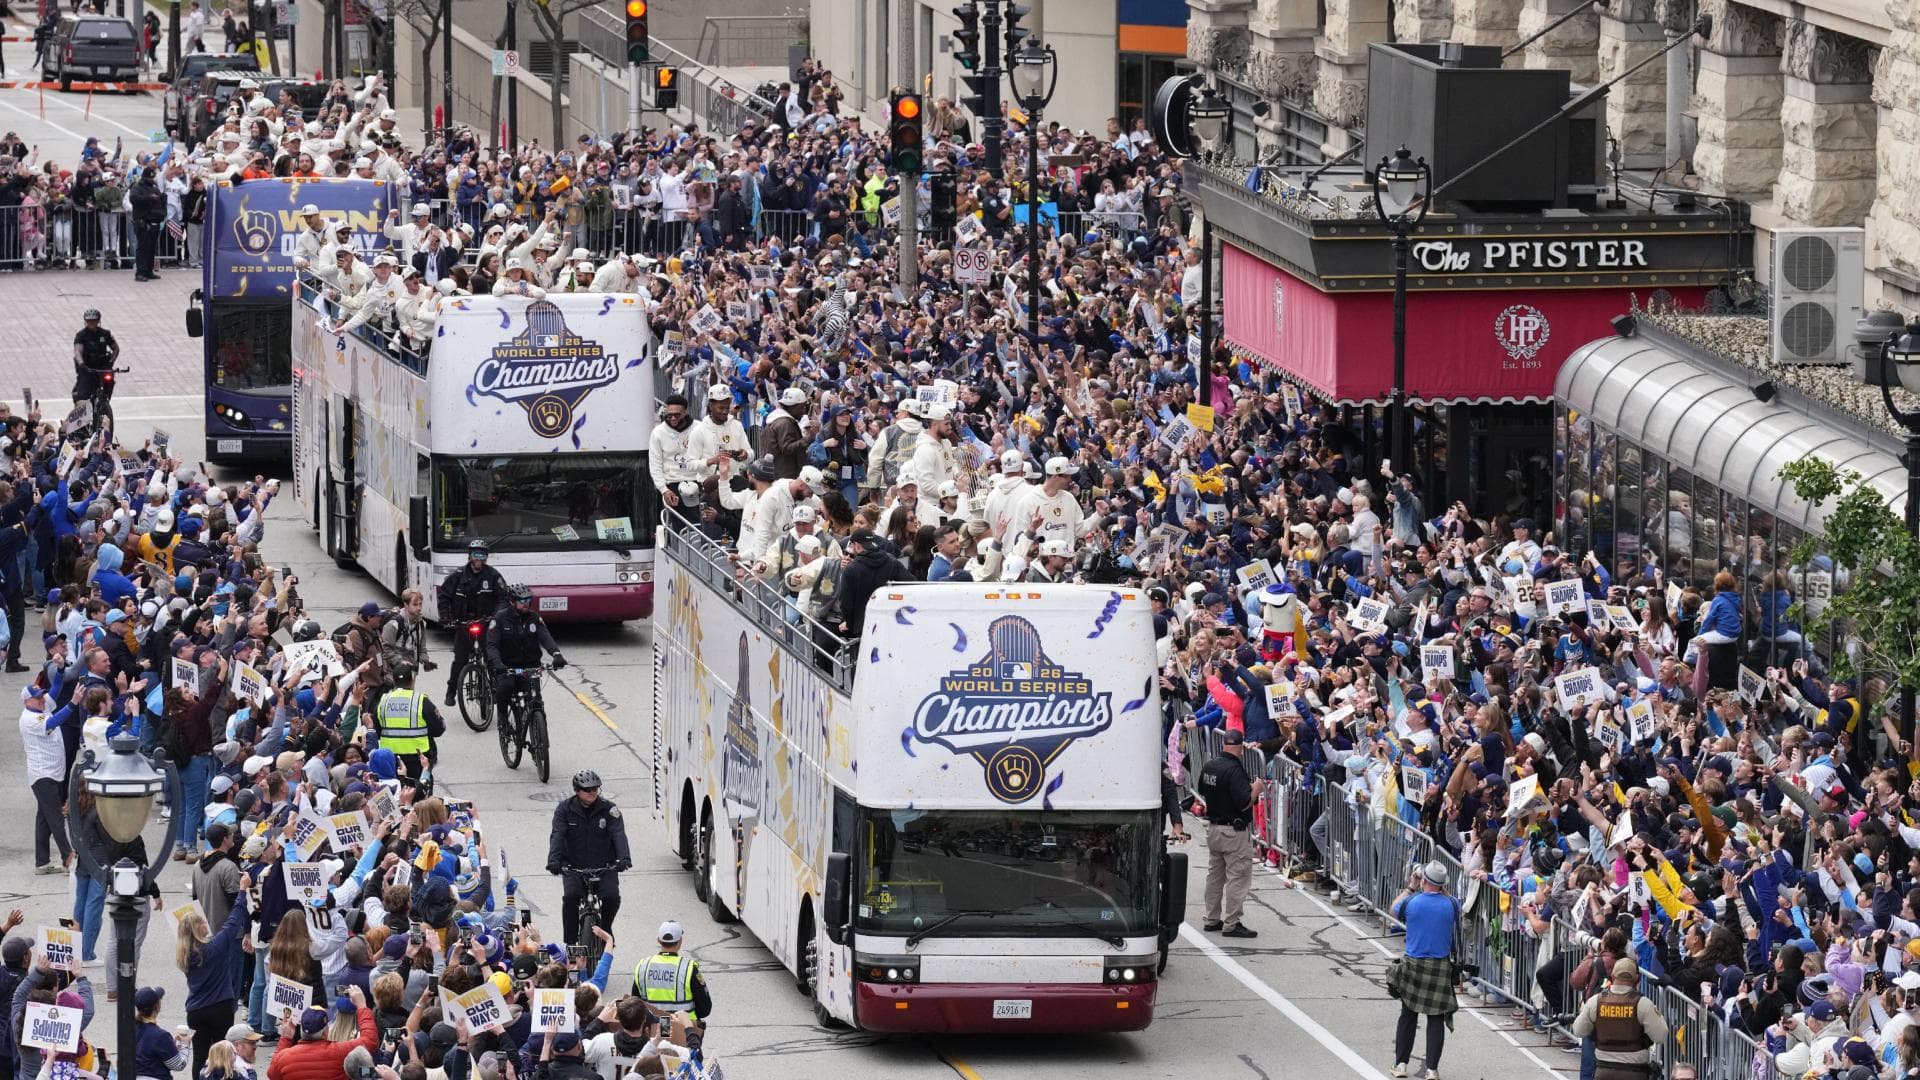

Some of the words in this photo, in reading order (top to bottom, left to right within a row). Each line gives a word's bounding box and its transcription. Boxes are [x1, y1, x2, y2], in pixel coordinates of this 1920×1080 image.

[1413, 241, 1471, 271] The
[1484, 240, 1647, 268] PFISTER
[514, 339, 530, 347] 20
[565, 338, 581, 346] 26
[495, 348, 547, 358] WORLD
[550, 347, 601, 357] SERIES
[1502, 360, 1518, 369] Est.
[1522, 360, 1542, 369] 1893
[476, 355, 618, 393] Champions
[153, 552, 168, 570] 8
[1248, 572, 1268, 584] OUR
[1251, 581, 1265, 591] WAY
[1551, 588, 1578, 605] CHAMPS
[1424, 654, 1447, 668] CHAMPS
[971, 667, 993, 677] 20
[1040, 669, 1062, 679] 26
[240, 681, 255, 696] WAY
[241, 676, 260, 691] OUR
[945, 680, 1014, 692] WORLD
[1019, 682, 1088, 694] SERIES
[1563, 679, 1593, 698] CHAMPS
[1272, 695, 1288, 704] OUR
[387, 703, 409, 712] POLICE
[1273, 703, 1285, 713] WAY
[916, 692, 1111, 743] Champions
[1635, 714, 1650, 726] OUR
[296, 822, 317, 847] OUR
[336, 825, 361, 836] OUR
[338, 832, 357, 846] WAY
[291, 871, 322, 888] CHAMPS
[308, 907, 332, 930] 10
[47, 943, 73, 954] OUR
[47, 952, 66, 964] WAY
[647, 969, 675, 983] POLICE
[274, 986, 305, 1011] CHAMPS
[465, 999, 495, 1017] OUR
[541, 1006, 566, 1015] OUR
[1600, 1004, 1634, 1018] SHERIFF
[469, 1009, 489, 1028] WAY
[540, 1014, 558, 1027] WAY
[32, 1018, 72, 1041] CHAMPS
[31, 1034, 69, 1046] WORLD
